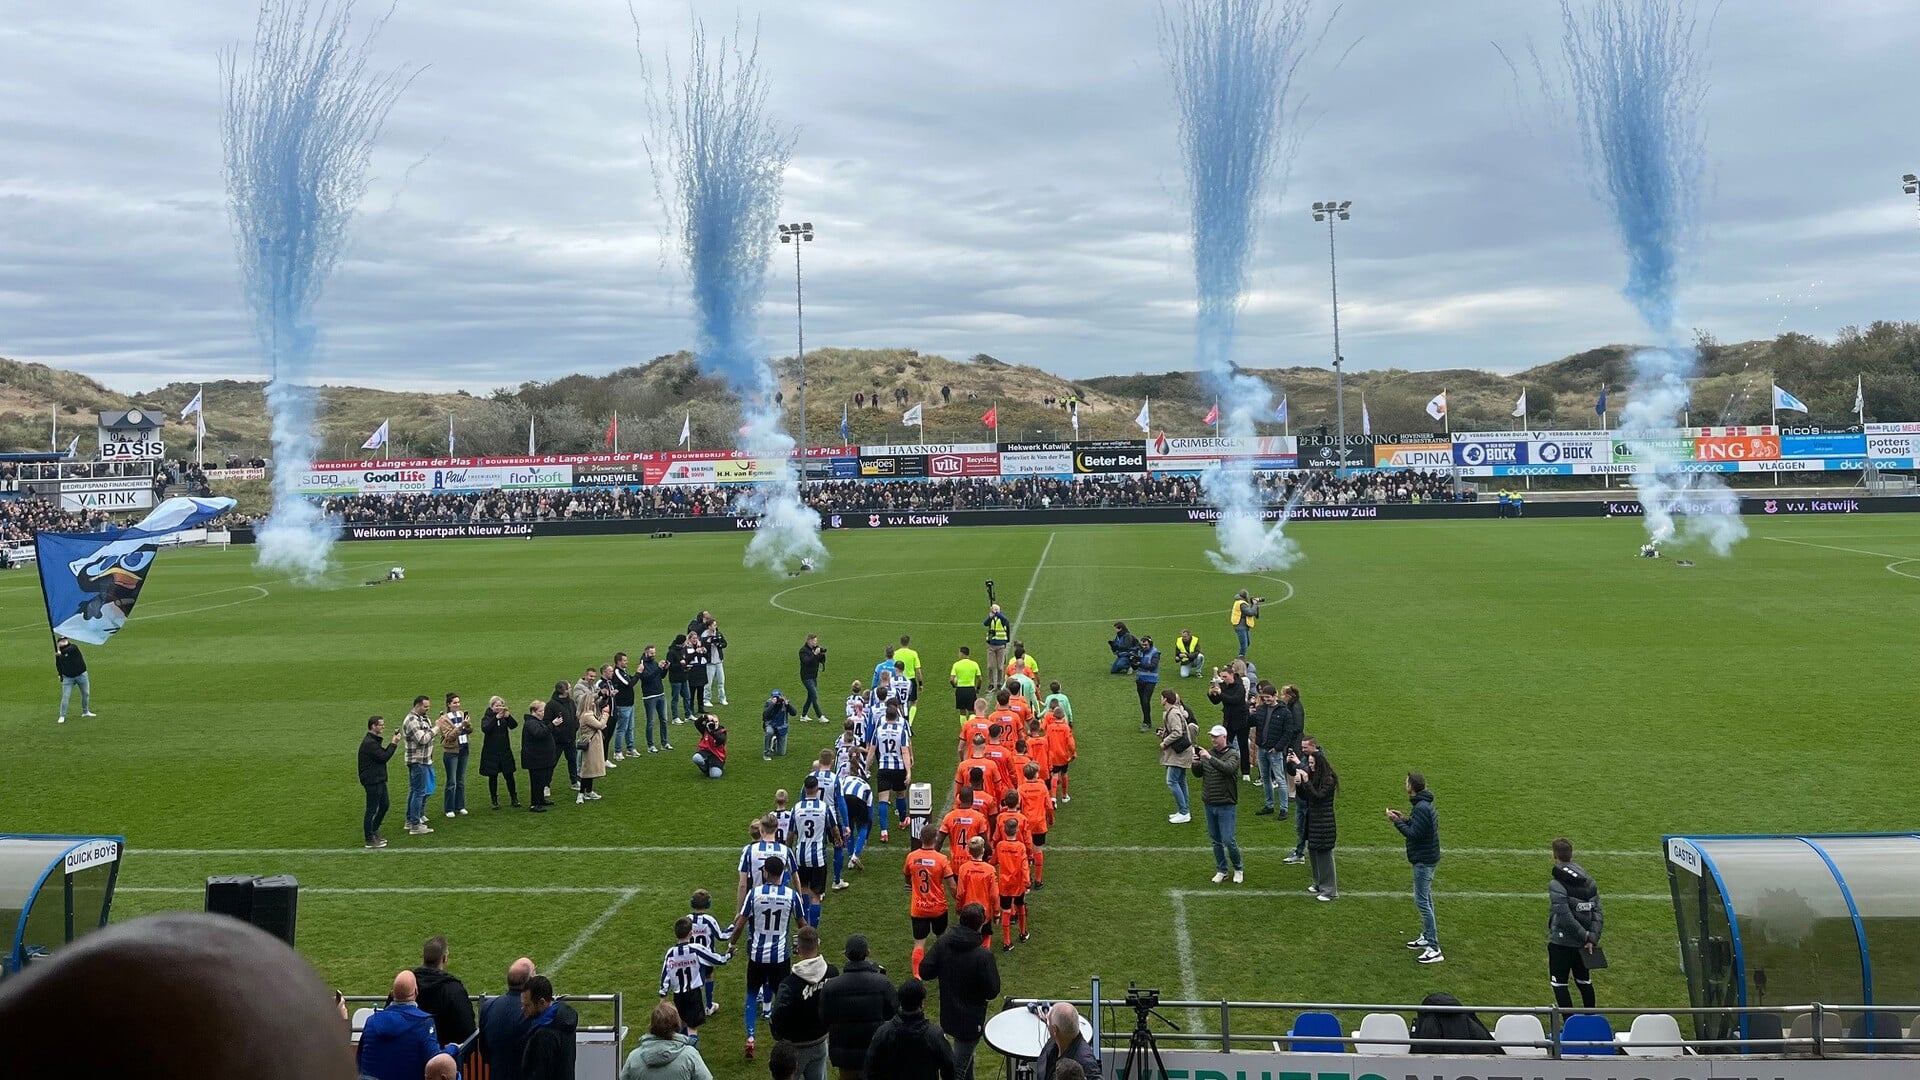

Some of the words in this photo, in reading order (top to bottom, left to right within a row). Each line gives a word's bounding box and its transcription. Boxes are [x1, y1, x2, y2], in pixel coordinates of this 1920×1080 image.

[1782, 425, 1820, 436] nico's
[1882, 424, 1901, 433] PLUG
[1171, 438, 1245, 448] GRIMBERGEN
[1346, 433, 1398, 445] KONING
[1869, 438, 1910, 447] potters
[103, 443, 163, 457] BASIS
[821, 448, 841, 456] Plas
[888, 445, 955, 455] HAASNOOT
[1042, 443, 1070, 451] Katwijk
[1563, 447, 1593, 459] BOCK
[1699, 443, 1745, 459] ING
[559, 455, 610, 466] Lange-van
[614, 454, 629, 462] der
[633, 453, 654, 461] Plas
[967, 456, 997, 464] Recycling
[1485, 448, 1517, 461] BOCK
[376, 459, 427, 470] Lange-van
[431, 458, 447, 467] der
[451, 457, 471, 466] Plas
[936, 459, 958, 471] vlk
[1085, 456, 1116, 467] Beter
[1118, 455, 1142, 466] Bed
[1326, 459, 1364, 468] Poeeest
[364, 471, 426, 482] GoodLife
[445, 469, 468, 483] Paul
[748, 469, 775, 478] Egmon
[1507, 467, 1558, 475] duocore
[510, 472, 562, 483] florisoft
[579, 474, 638, 482] AANDEWIEL
[79, 492, 136, 504] VARINK
[1610, 504, 1642, 513] K.v.v.
[1787, 502, 1808, 510] v.v.
[1811, 500, 1859, 512] Katwijk
[887, 517, 906, 525] v.v.
[909, 514, 949, 526] Katwijk
[1256, 508, 1309, 521] sportpark
[1312, 508, 1349, 517] Nieuw
[1352, 507, 1377, 517] Zuid
[737, 519, 762, 528] K.v.v
[353, 528, 396, 538] Welkom
[399, 529, 412, 540] op
[414, 527, 466, 540] sportpark
[468, 526, 501, 535] Nieuw
[504, 524, 527, 534] Zuid
[855, 722, 863, 737] 4
[883, 739, 897, 753] 12
[804, 820, 815, 838] 3
[957, 828, 968, 850] 4
[67, 851, 92, 866] QUICK
[94, 844, 116, 859] BOYS
[1674, 846, 1696, 866] GASTEN
[918, 869, 929, 894] 3
[762, 908, 782, 931] 11
[676, 967, 692, 993] 11
